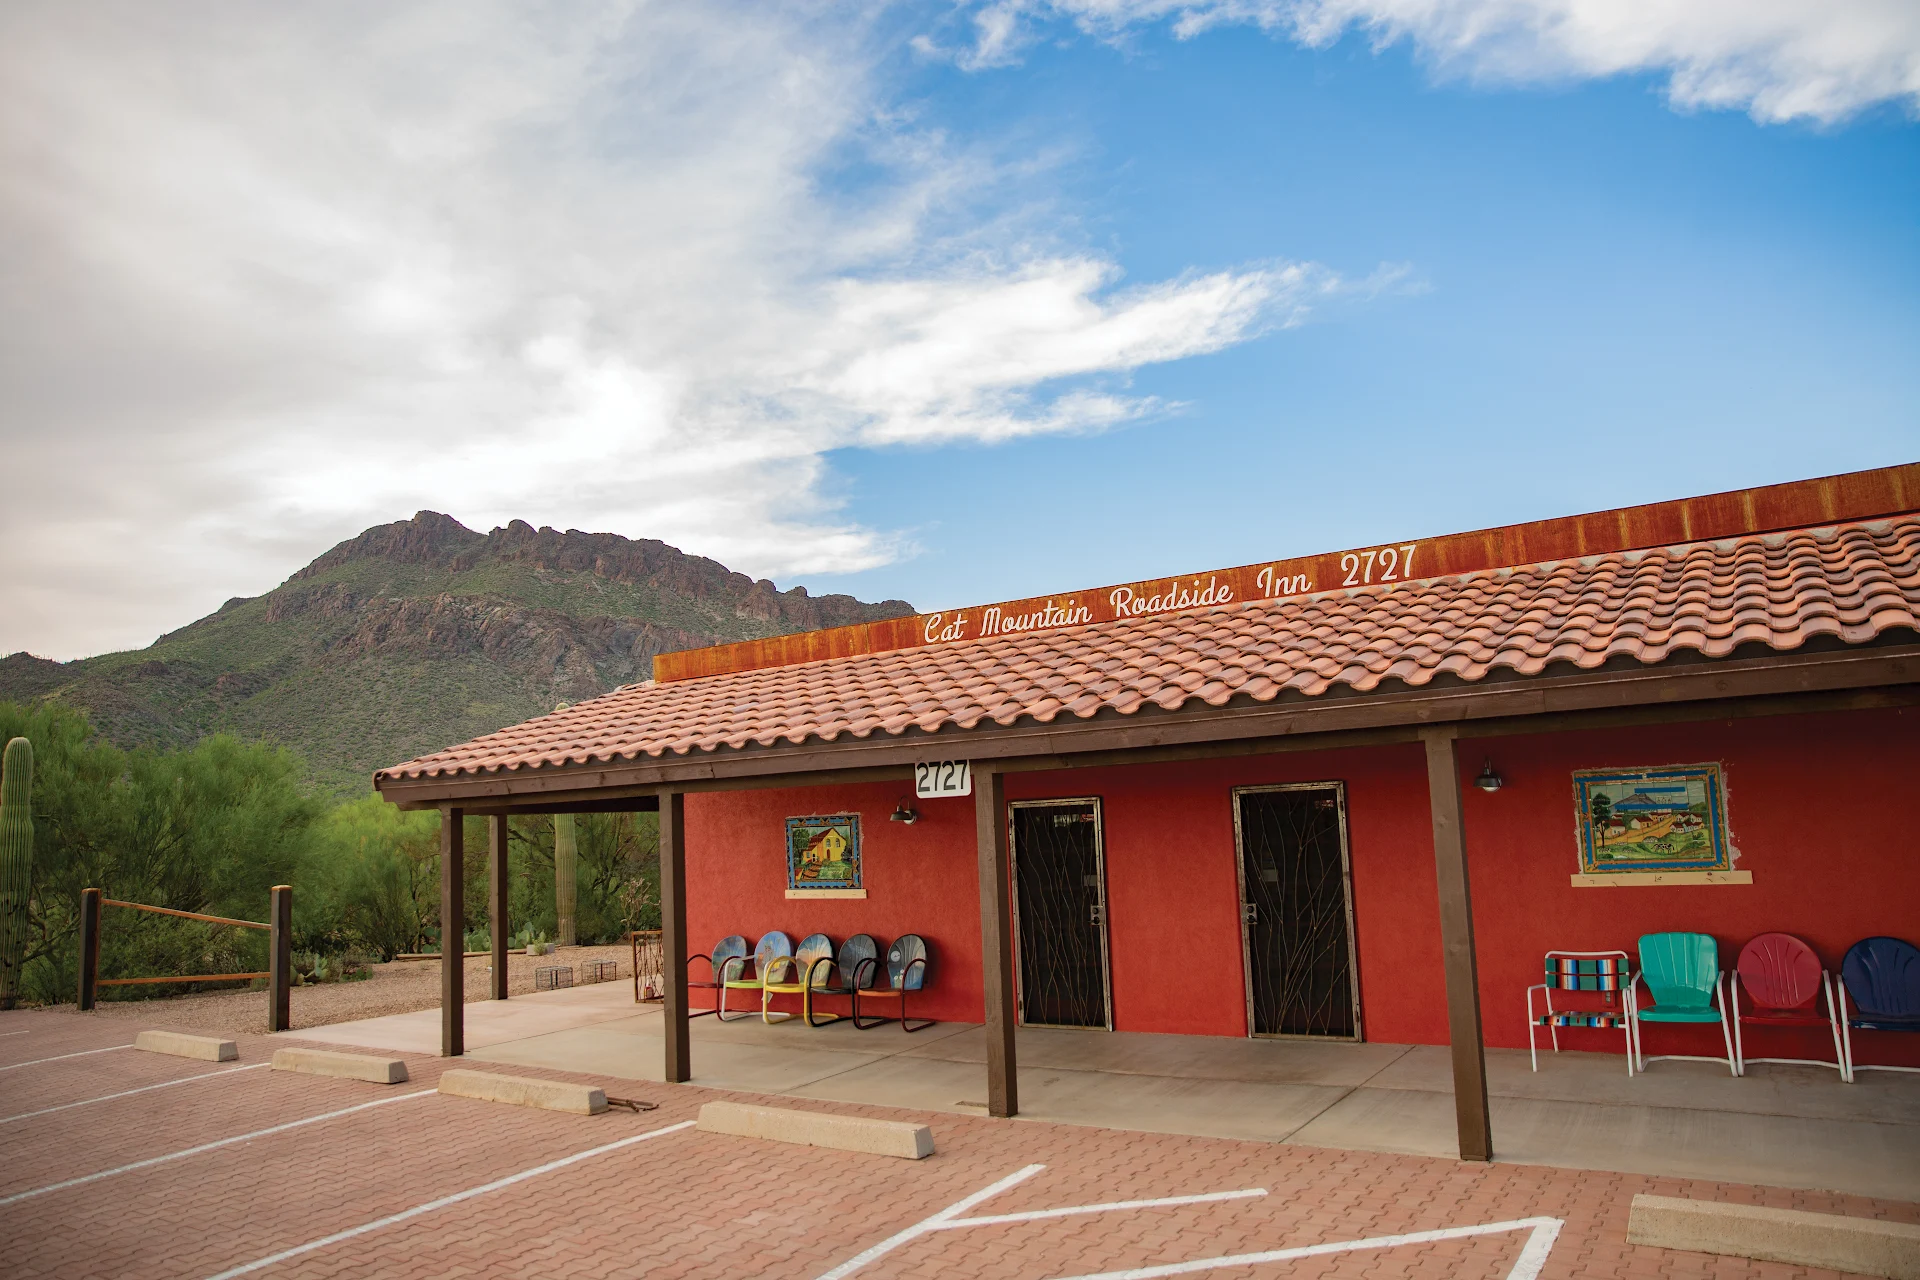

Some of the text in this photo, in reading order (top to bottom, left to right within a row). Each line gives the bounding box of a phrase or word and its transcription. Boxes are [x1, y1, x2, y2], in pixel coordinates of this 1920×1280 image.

[924, 546, 1416, 643] Cat Mountain Roadside Inn 2727
[917, 760, 967, 792] 2727
